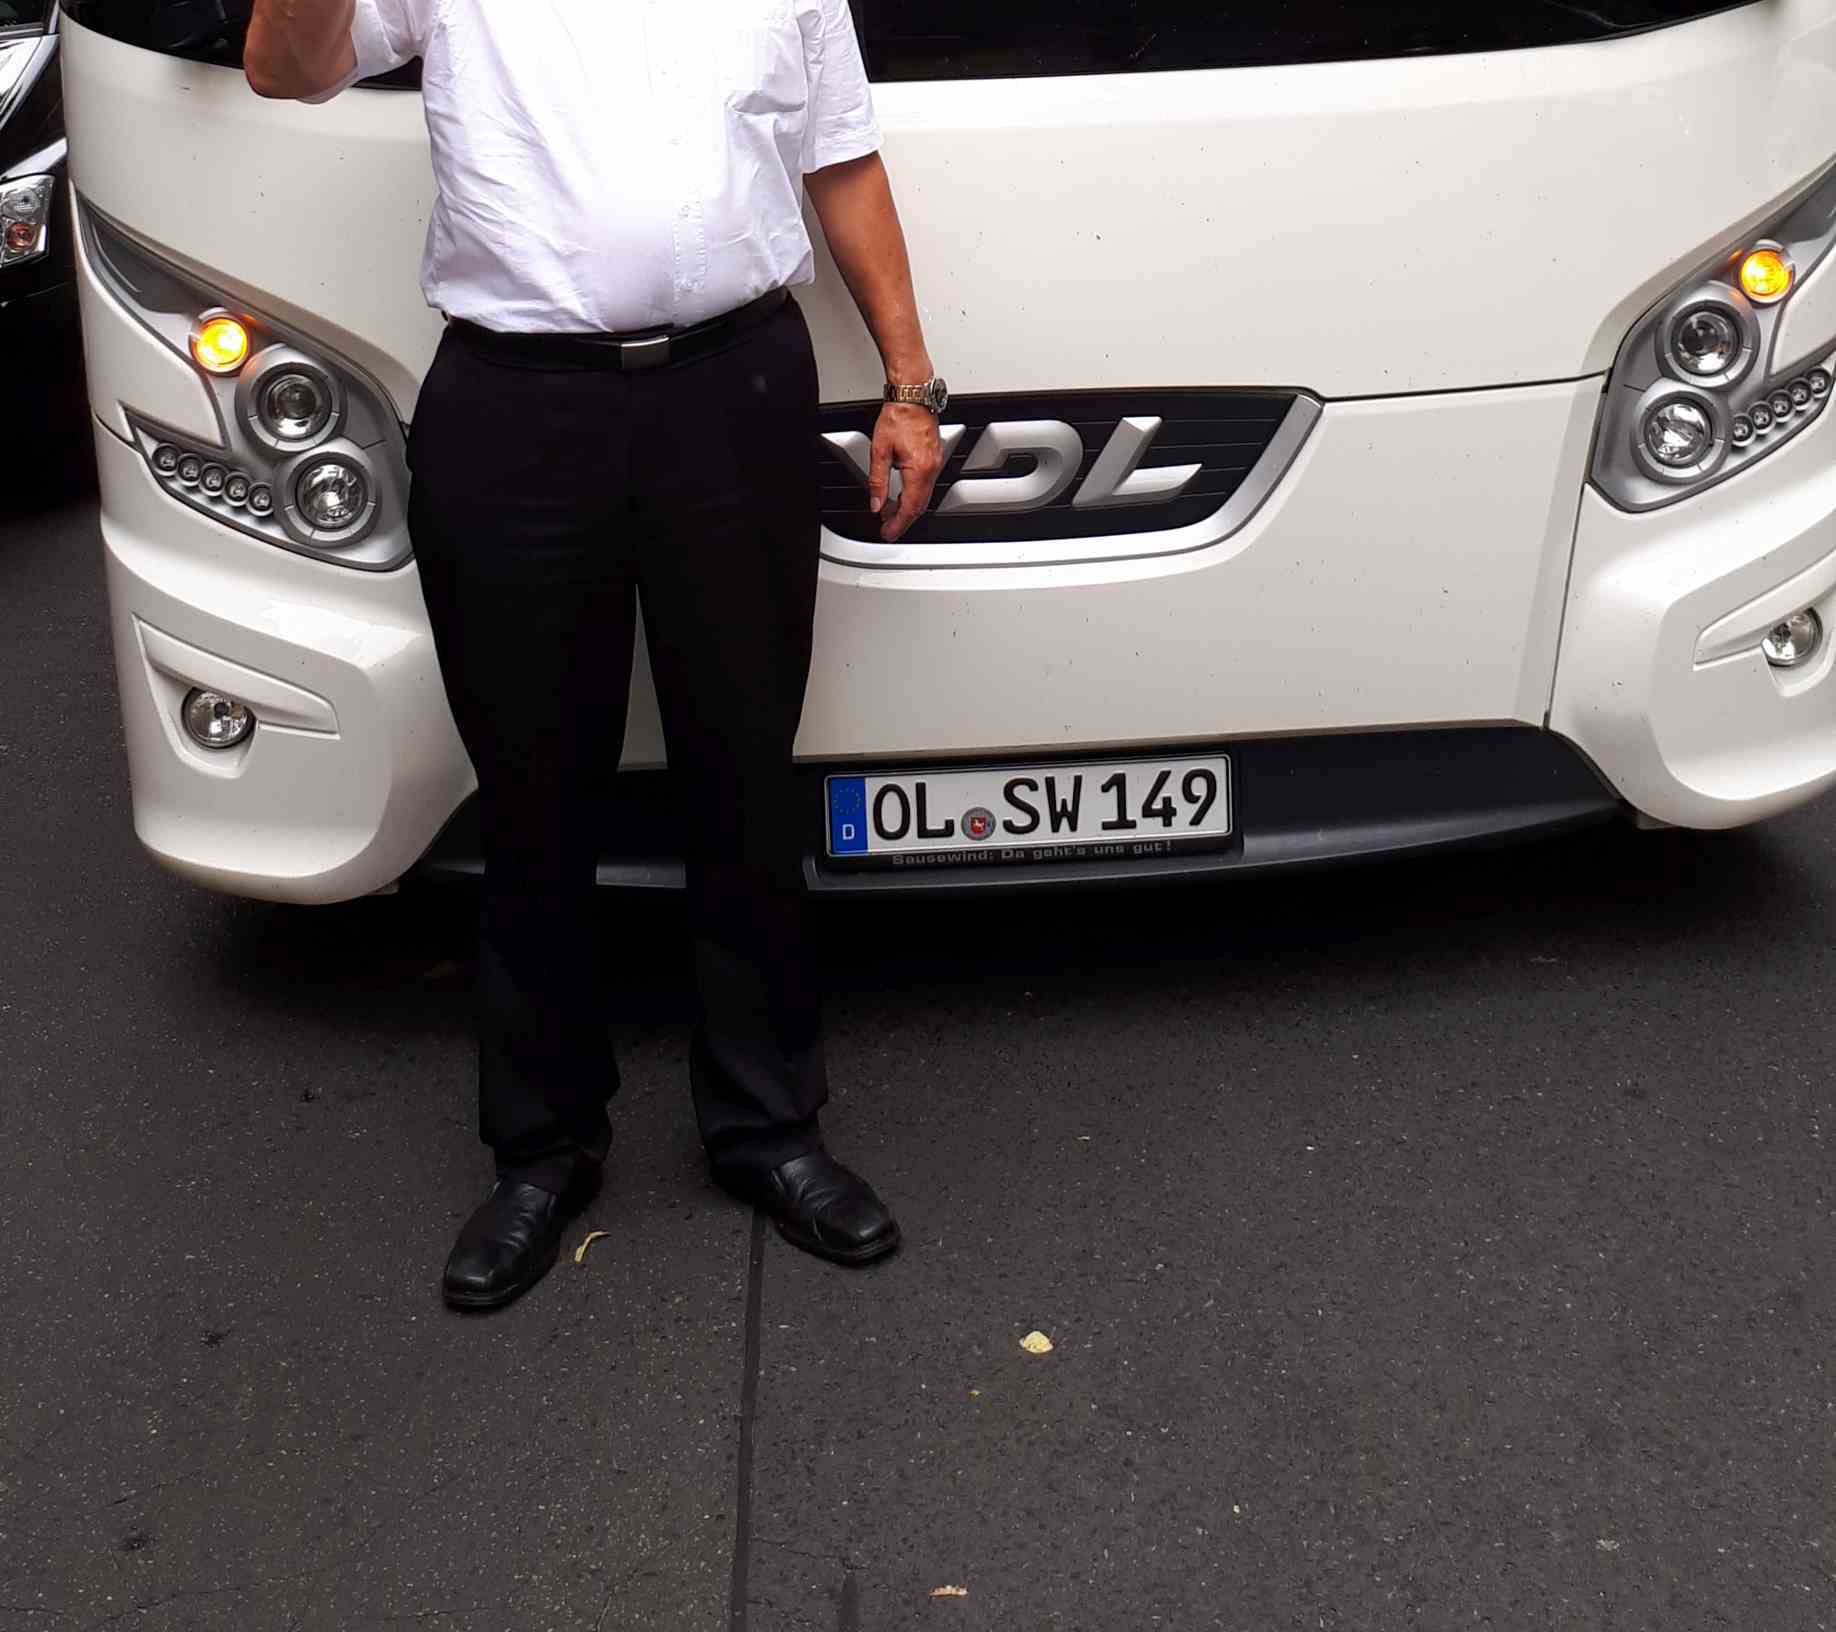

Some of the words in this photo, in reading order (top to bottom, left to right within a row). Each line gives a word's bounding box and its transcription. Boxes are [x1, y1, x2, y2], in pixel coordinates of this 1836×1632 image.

[872, 781, 955, 841] OL
[1002, 774, 1082, 836] SW
[1100, 768, 1218, 832] 149
[842, 823, 855, 841] D
[892, 851, 994, 866] Sausewind:
[1001, 848, 1026, 860] Da
[1033, 844, 1086, 860] geht's
[1094, 844, 1125, 856] uns
[1133, 840, 1172, 856] gut!
